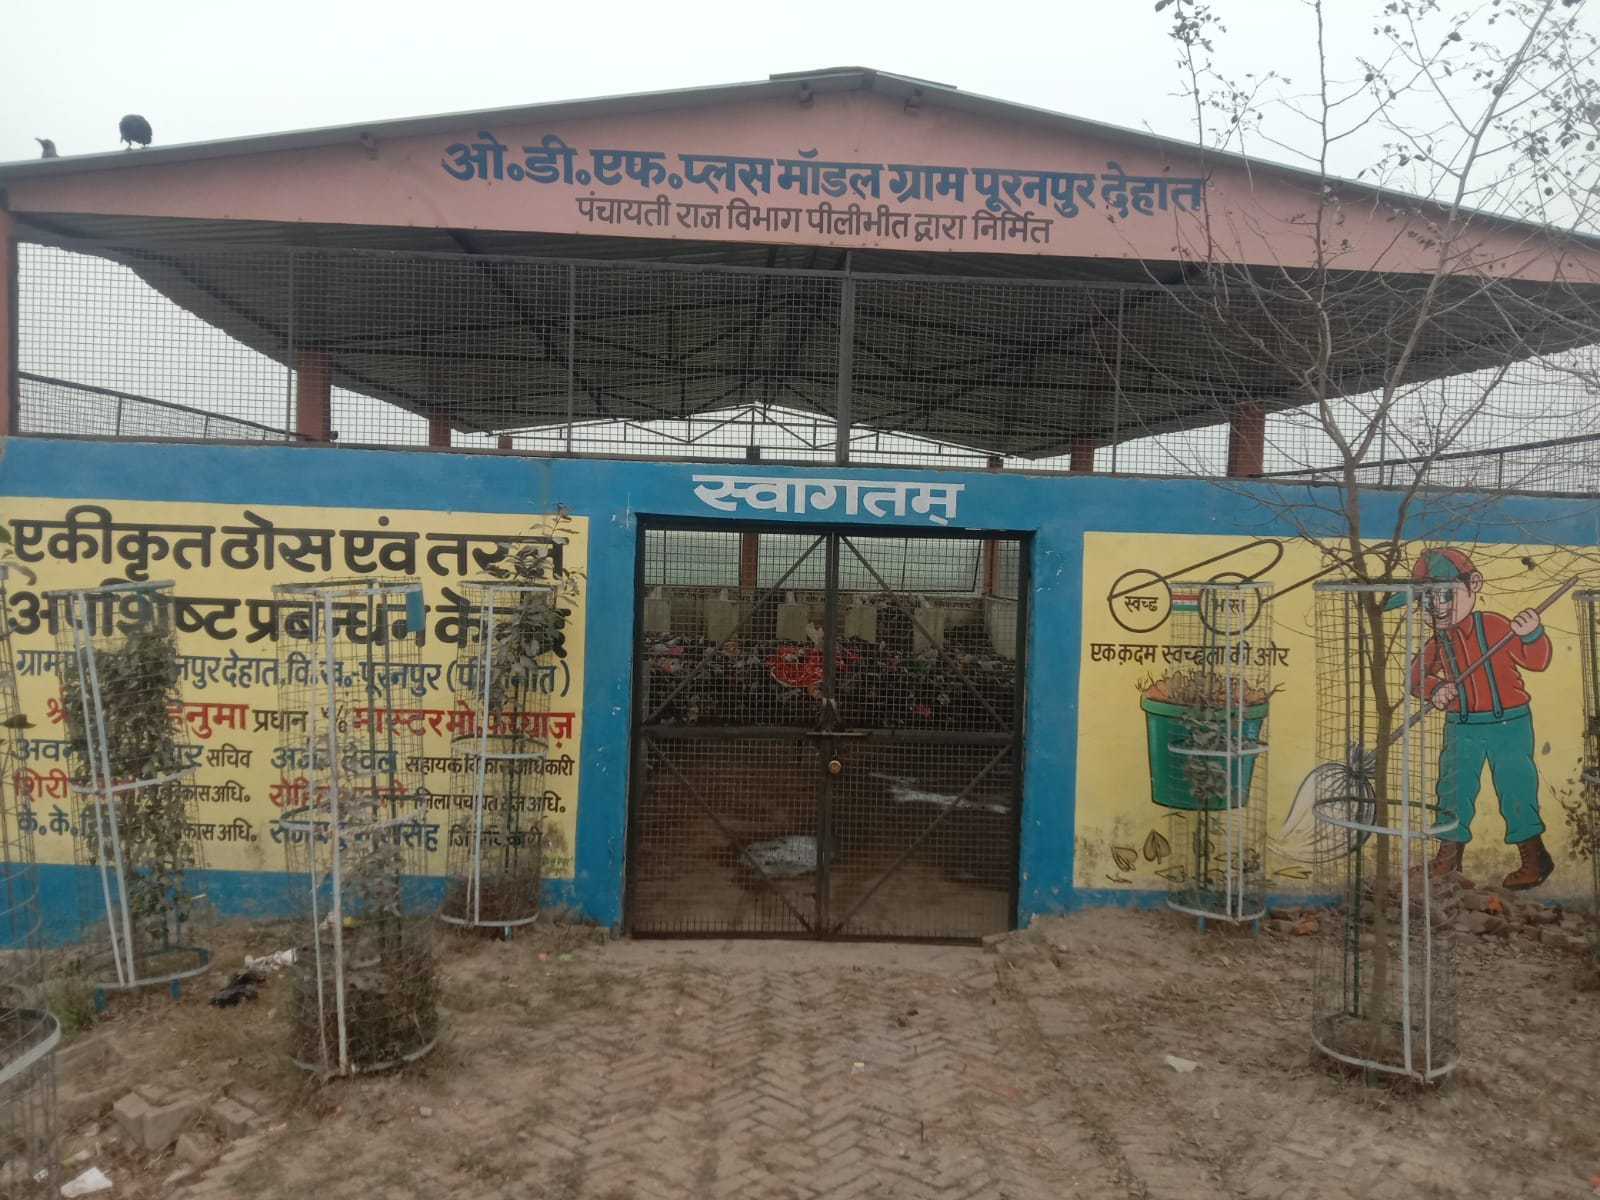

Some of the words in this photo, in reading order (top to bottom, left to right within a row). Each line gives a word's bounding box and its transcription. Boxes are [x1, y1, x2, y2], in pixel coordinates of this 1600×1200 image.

[777, 148, 884, 199] मॉडल
[888, 164, 968, 203] ग्राम
[971, 168, 1096, 218] पूरनपुर
[1100, 161, 1205, 218] देहात
[576, 191, 671, 227] पंचायती
[676, 200, 723, 229] राज
[727, 198, 802, 232] विभाग
[807, 202, 911, 238] पीलीभीत
[914, 213, 967, 242] द्वारा
[972, 209, 1053, 243] निर्मित
[692, 474, 965, 526] स्वागतम्
[9, 505, 215, 581] एकीकृत
[221, 510, 335, 571] ठोस
[1125, 595, 1159, 613] स्वच्छ
[1091, 643, 1115, 662] एक
[1254, 641, 1290, 666] ओर
[252, 709, 308, 733] प्रधान
[207, 743, 252, 768] सचिव
